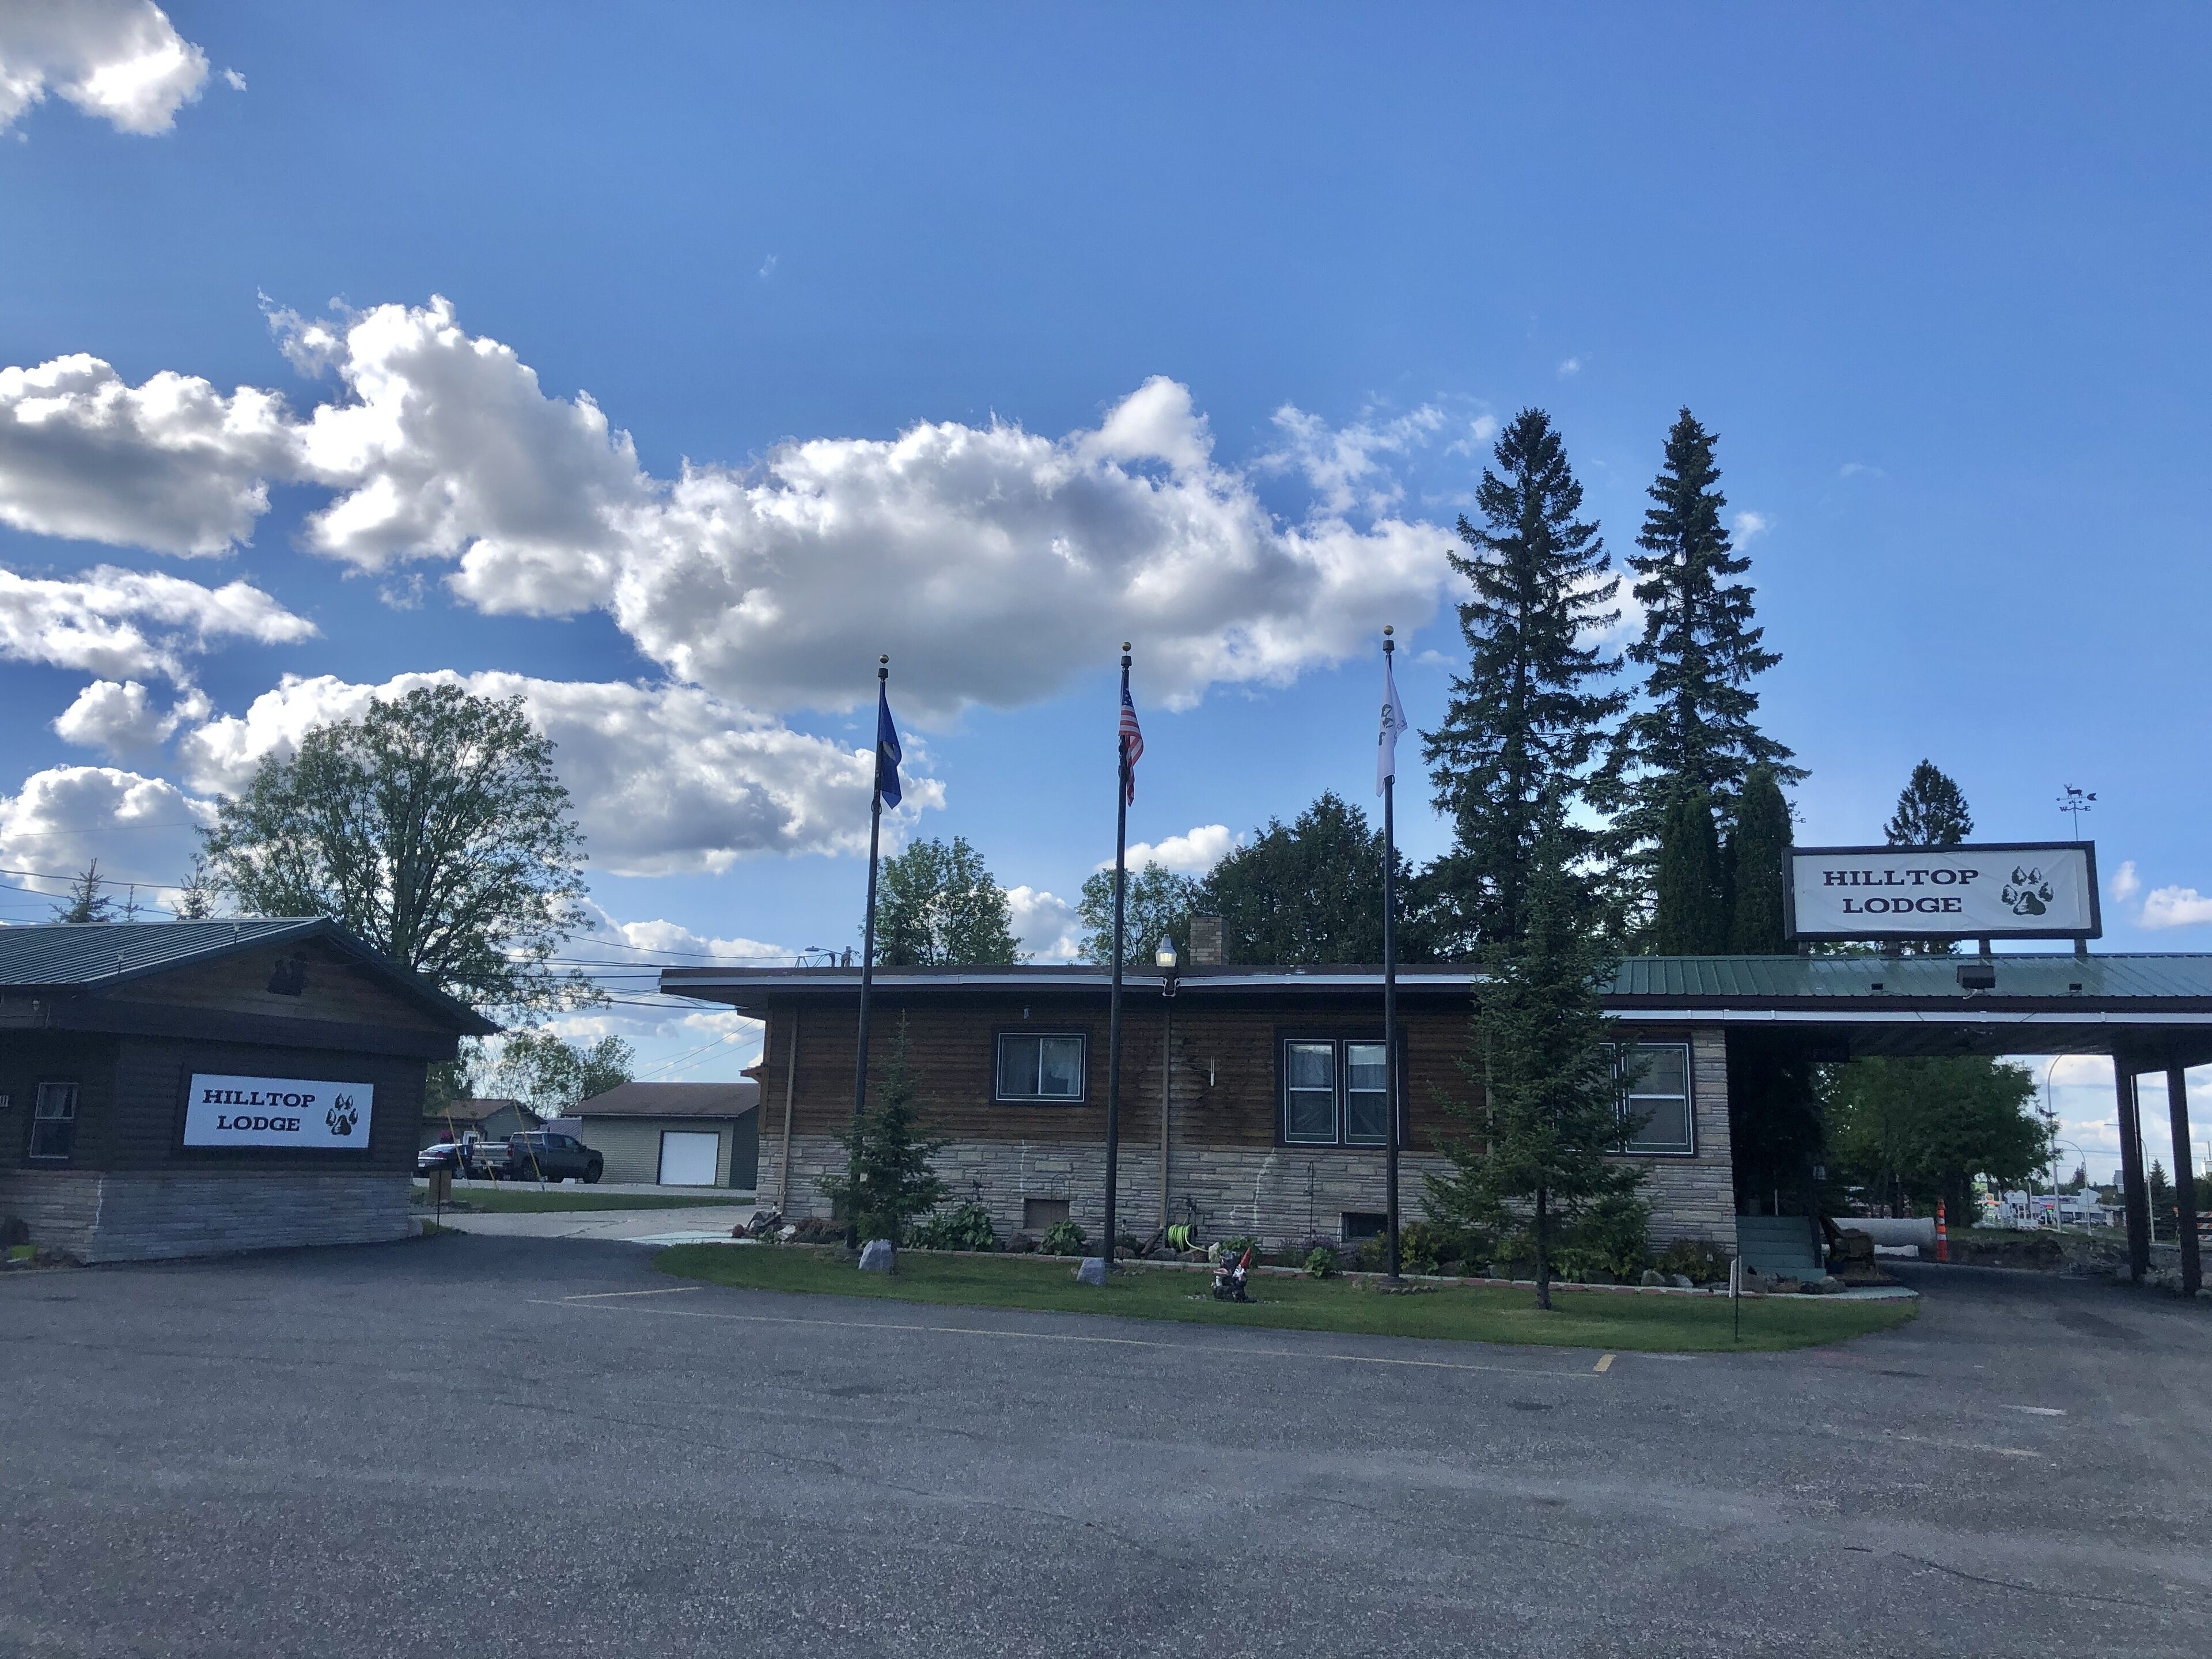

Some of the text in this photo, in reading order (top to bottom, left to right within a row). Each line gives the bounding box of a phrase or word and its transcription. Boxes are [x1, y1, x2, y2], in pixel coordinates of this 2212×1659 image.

[1823, 869, 1979, 886] HILLTOP
[1842, 897, 1962, 914] LODGE
[202, 1089, 316, 1108] HILLTOP
[216, 1115, 301, 1131] LODGE
